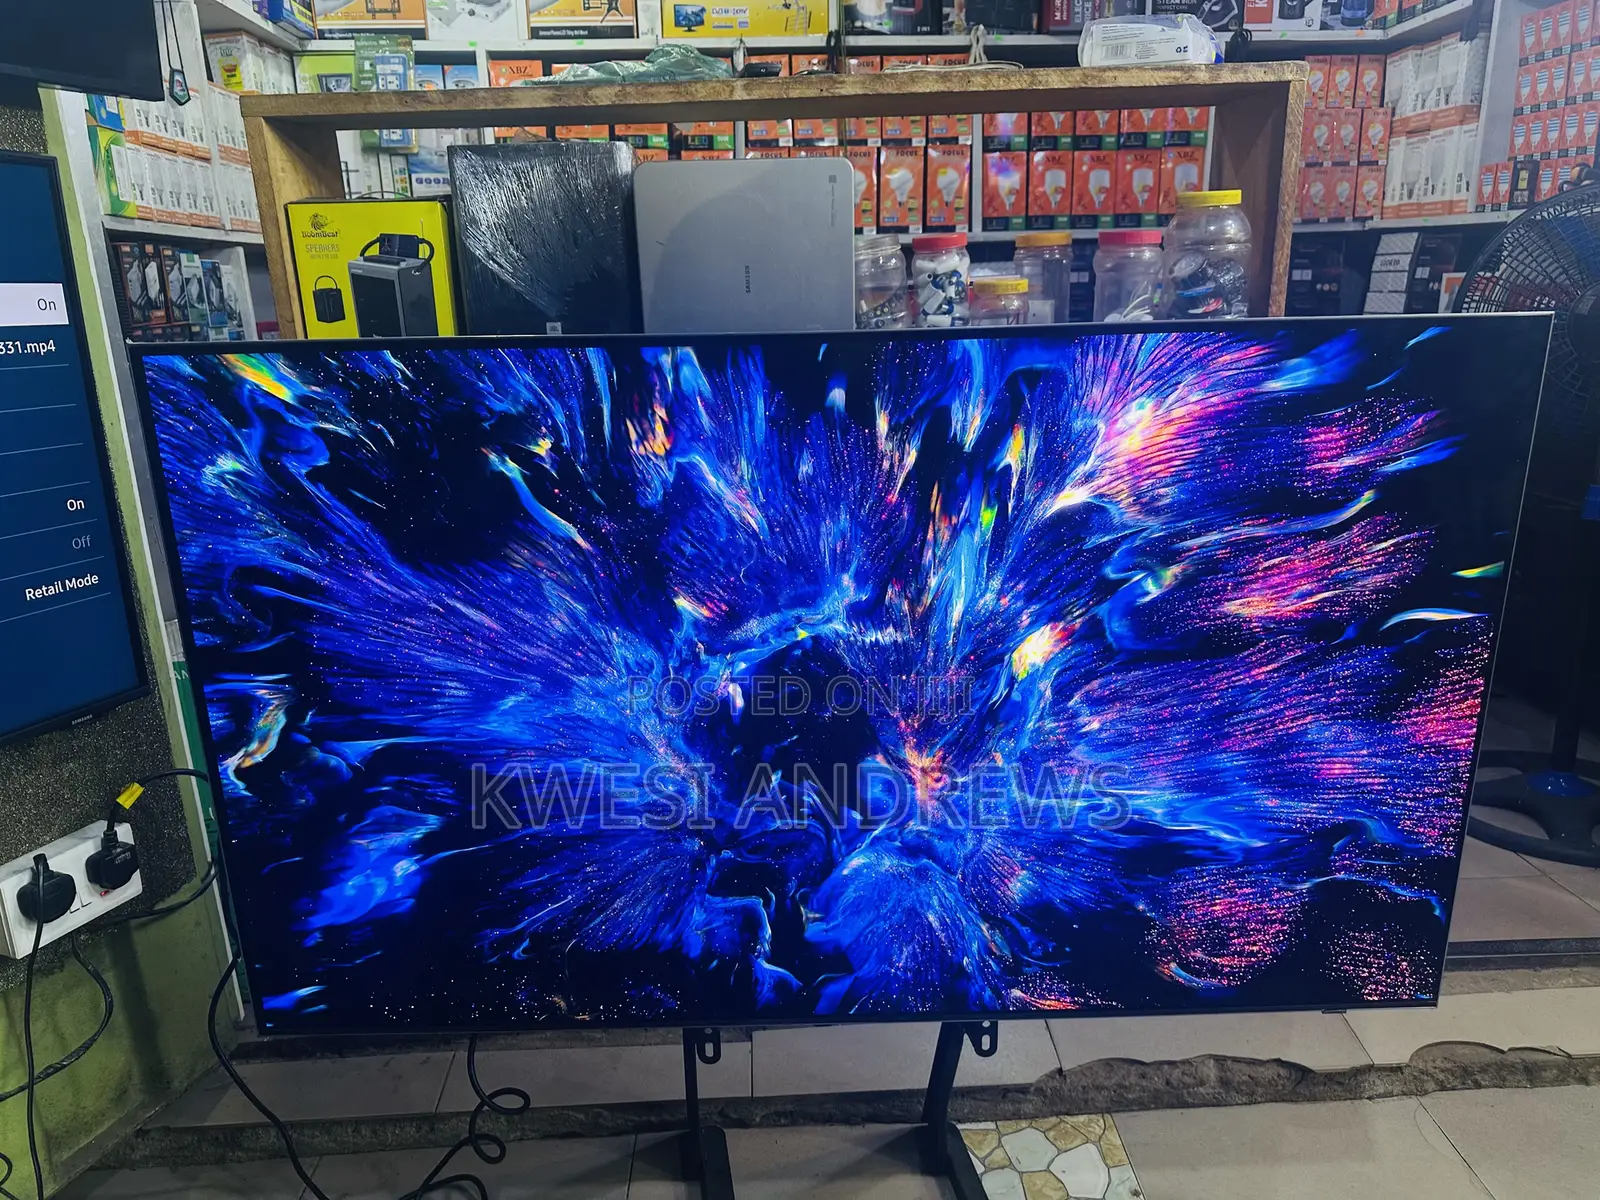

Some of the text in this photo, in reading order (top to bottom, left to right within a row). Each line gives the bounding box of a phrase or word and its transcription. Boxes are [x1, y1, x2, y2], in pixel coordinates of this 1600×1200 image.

[509, 66, 530, 75] XBZ
[305, 243, 340, 253] SPEAKERS
[37, 298, 57, 311] On
[67, 499, 85, 511] On
[72, 535, 92, 550] Off
[25, 573, 99, 601] Retail Mode
[71, 713, 93, 726] SAMSUNG
